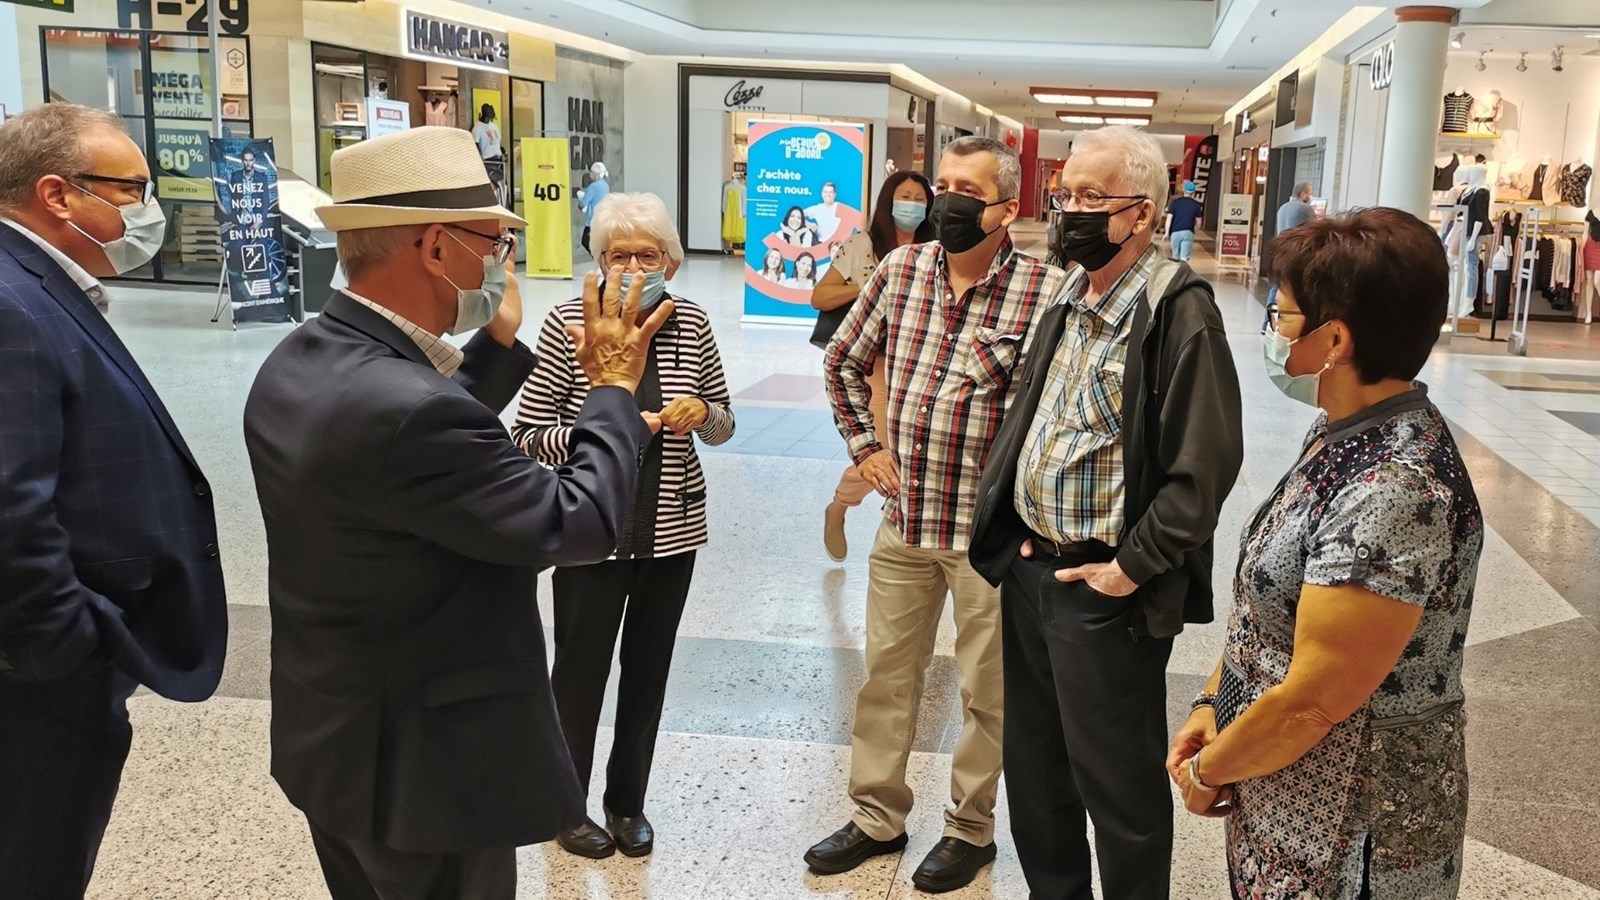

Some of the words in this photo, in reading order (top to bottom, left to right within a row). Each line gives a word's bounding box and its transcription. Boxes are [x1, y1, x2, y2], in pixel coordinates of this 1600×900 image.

[152, 71, 203, 89] MÉGA
[153, 91, 205, 105] VENTE
[568, 96, 604, 135] HAN
[158, 133, 203, 145] JUSQU'À
[159, 148, 204, 171] 80%
[570, 136, 604, 171] GAR
[757, 168, 802, 180] J'achète
[1191, 157, 1212, 203] ENTE
[229, 183, 265, 193] VENEZ
[756, 182, 782, 193] chez
[784, 186, 812, 195] nous.
[231, 198, 263, 209] NOUS
[236, 213, 264, 224] VOIR
[1231, 208, 1243, 216] 50
[229, 230, 244, 240] EN
[245, 227, 275, 239] HAUT
